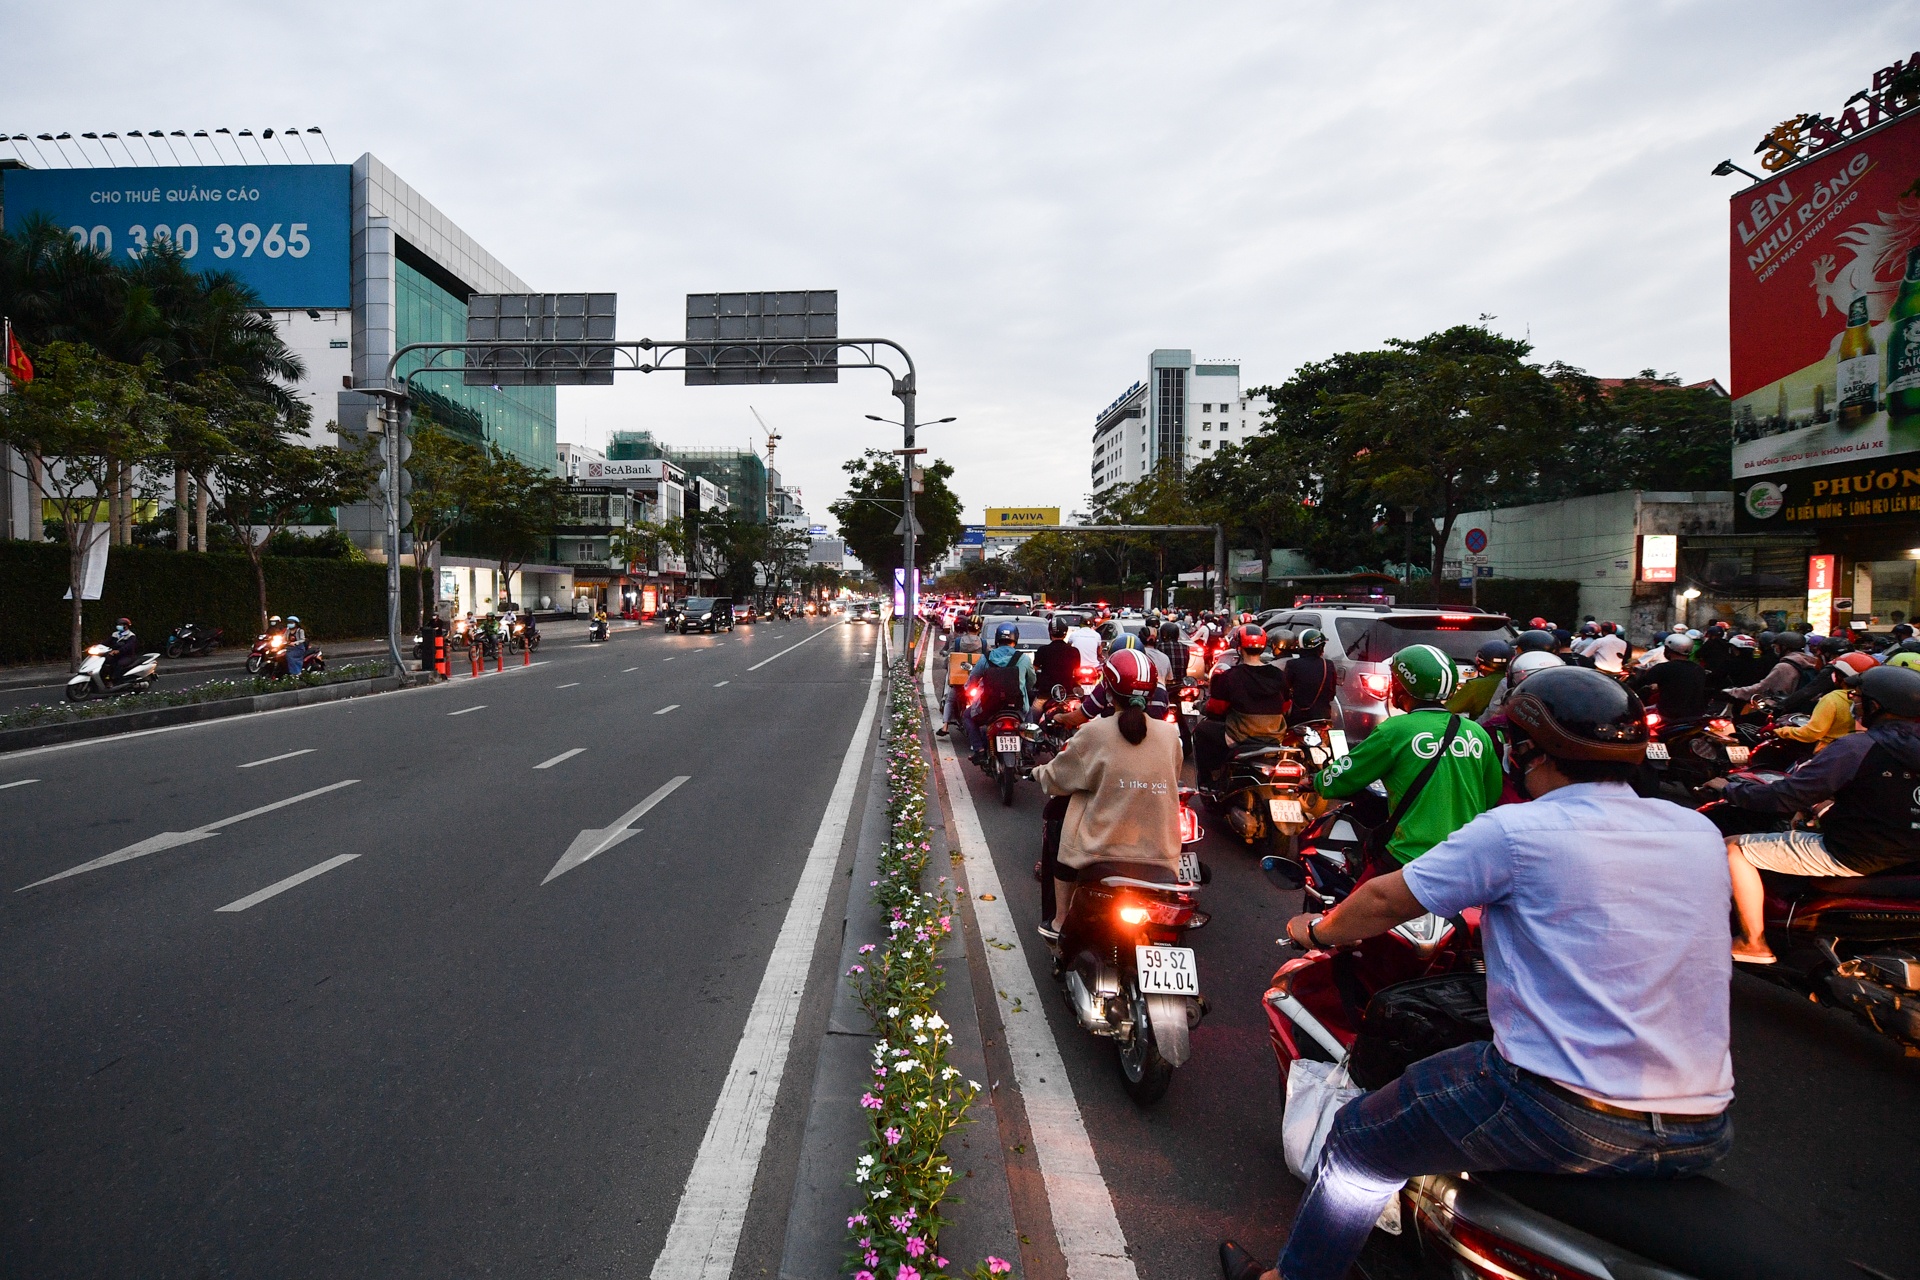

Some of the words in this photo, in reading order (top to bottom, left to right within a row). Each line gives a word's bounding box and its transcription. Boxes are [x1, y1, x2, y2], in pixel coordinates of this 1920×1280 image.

[90, 190, 121, 203] CHO
[125, 187, 161, 203] THUÊ
[166, 185, 222, 202] QUẢNG
[226, 185, 260, 202] CÁO
[1737, 180, 1794, 246] LÊN
[1747, 217, 1792, 271] NHƯ
[1798, 152, 1870, 225] RỒNG
[126, 223, 199, 259] 380
[213, 222, 311, 259] 3965
[1805, 451, 1819, 459] BIA
[1821, 445, 1854, 456] KHÔNG
[1872, 440, 1884, 449] XE
[604, 465, 651, 476] SeABank
[1872, 497, 1889, 514] HEO
[1011, 513, 1044, 521] AVIVA
[1397, 662, 1417, 685] Grab
[1119, 778, 1125, 788] I
[1129, 780, 1148, 789] like
[1151, 780, 1168, 791] you
[1274, 802, 1296, 811] 59-P1
[1273, 811, 1301, 821] 926.18
[1145, 949, 1188, 970] 59-S2
[1142, 970, 1195, 991] 744.04
